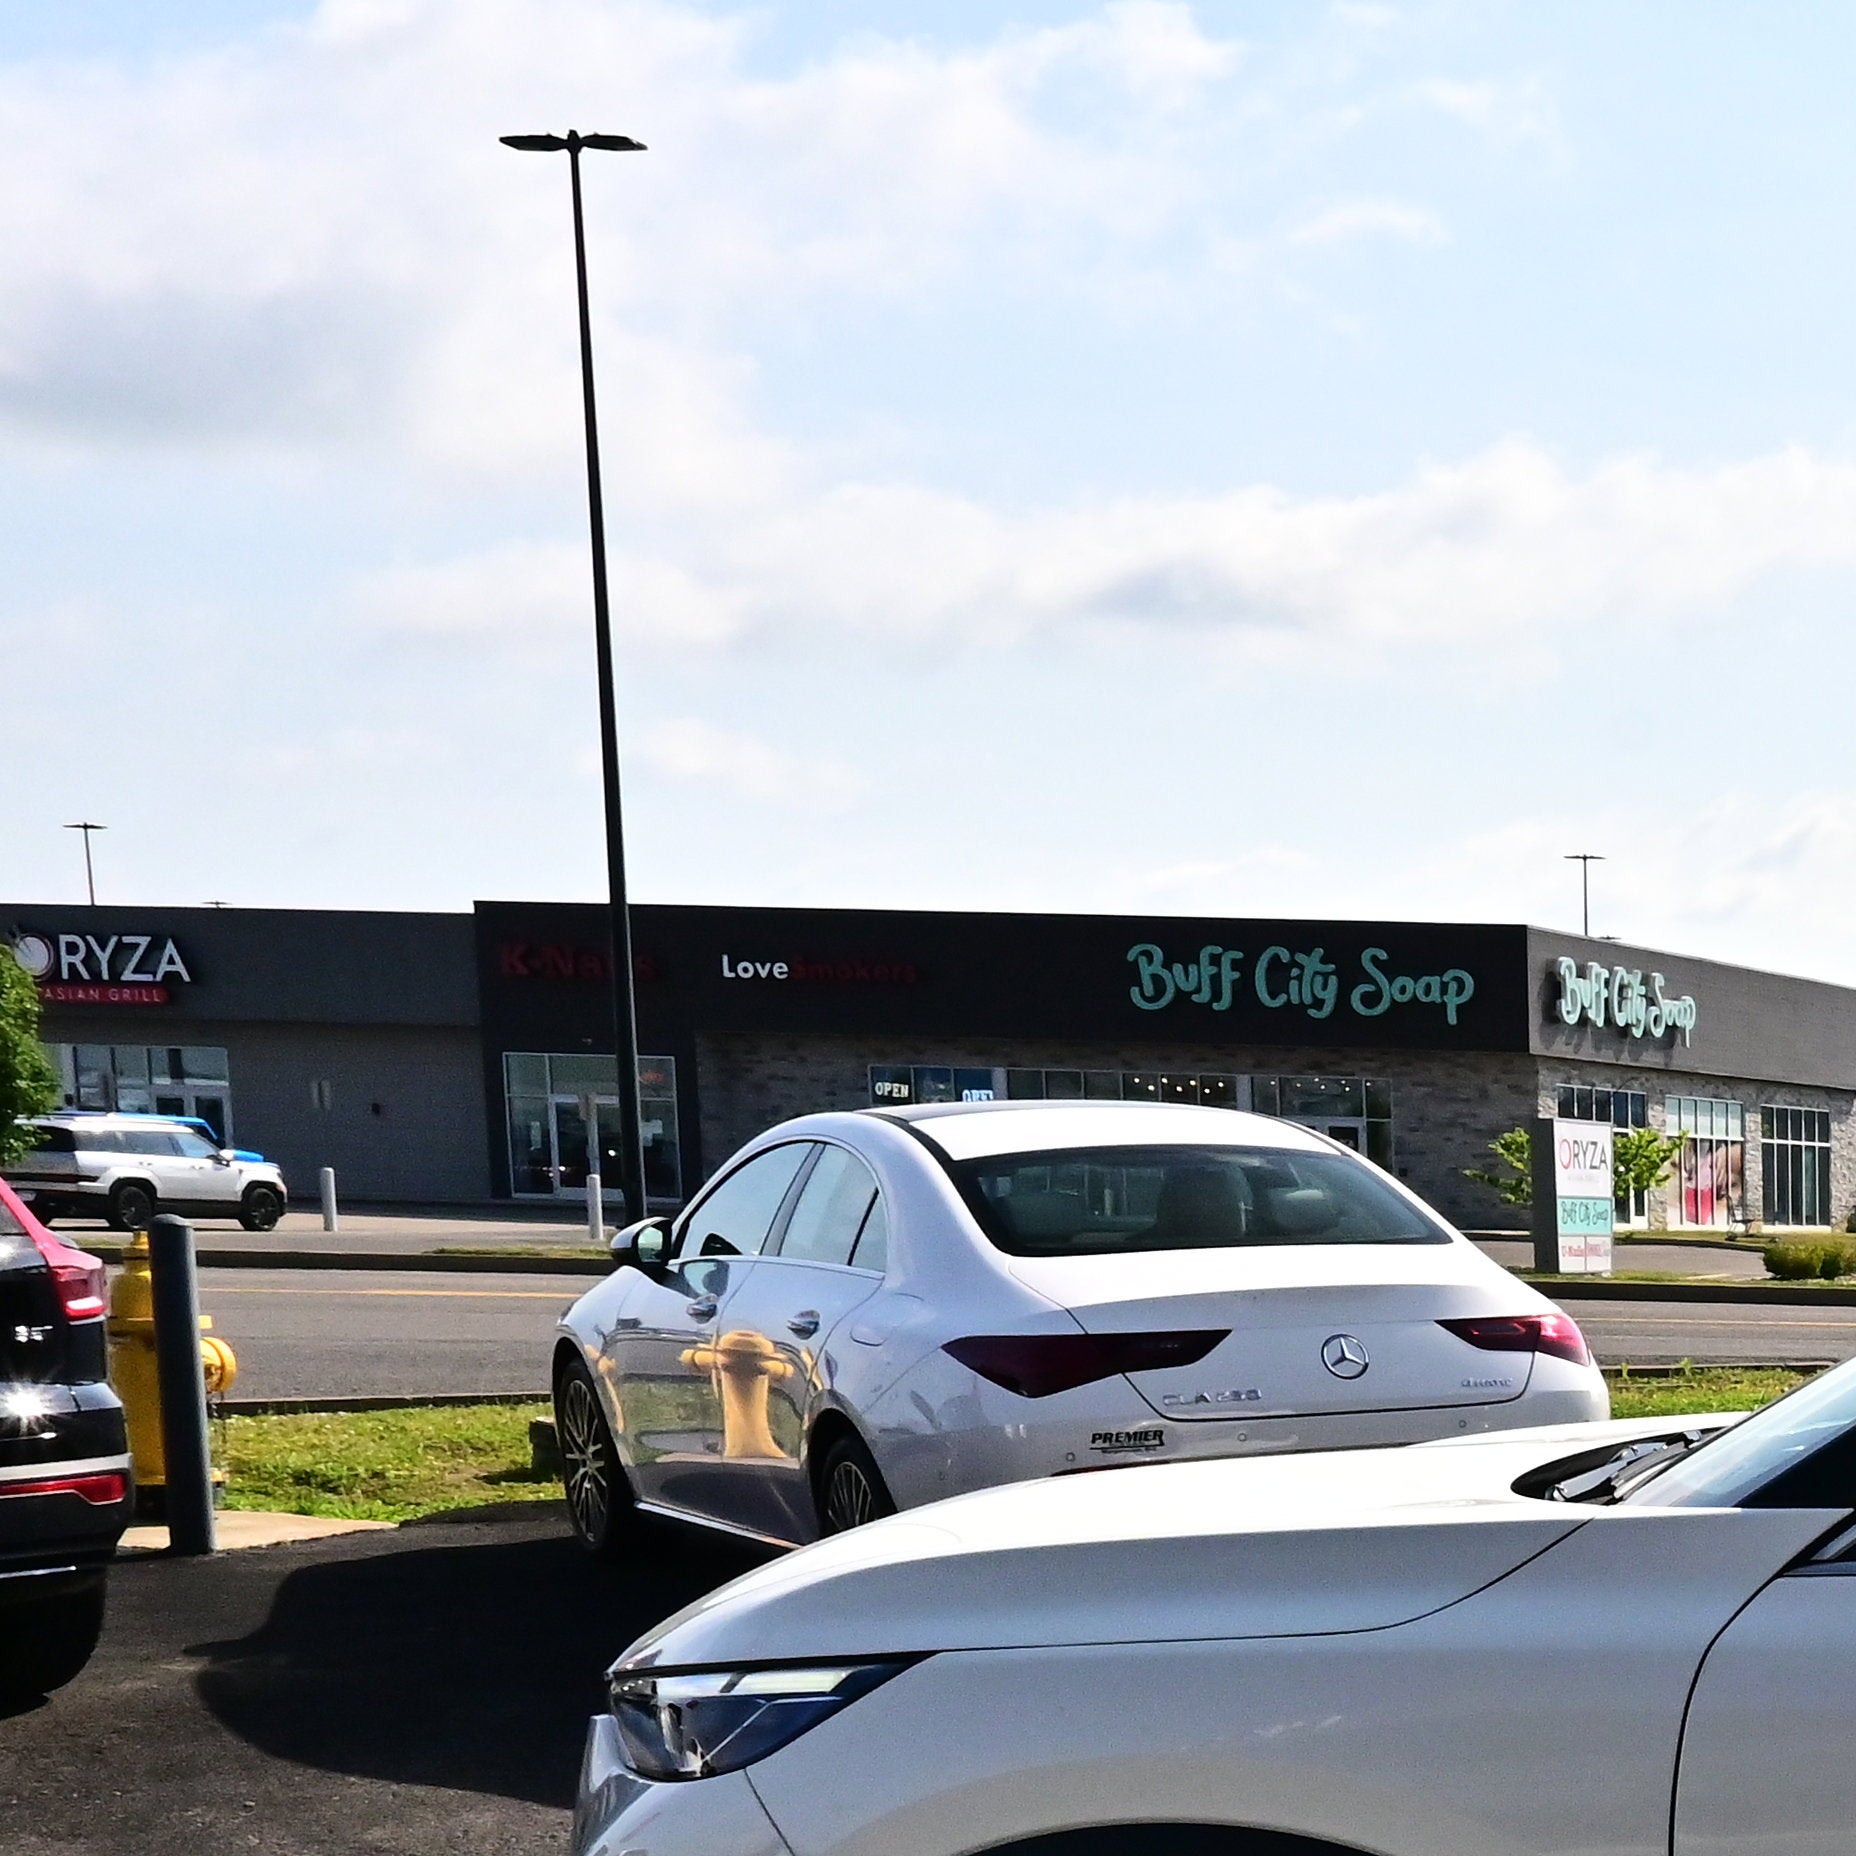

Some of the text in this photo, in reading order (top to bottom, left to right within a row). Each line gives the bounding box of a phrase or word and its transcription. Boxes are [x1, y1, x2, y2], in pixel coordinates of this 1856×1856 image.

[721, 954, 789, 980] Love
[44, 987, 161, 1002] ASIAN GRILL
[1126, 943, 1475, 1026] Buff City Soap
[1557, 956, 1697, 1049] Buff City Soap
[874, 1082, 909, 1098] OPEN
[1558, 1138, 1608, 1170] ORYZA
[1091, 1430, 1165, 1446] PREMIER
